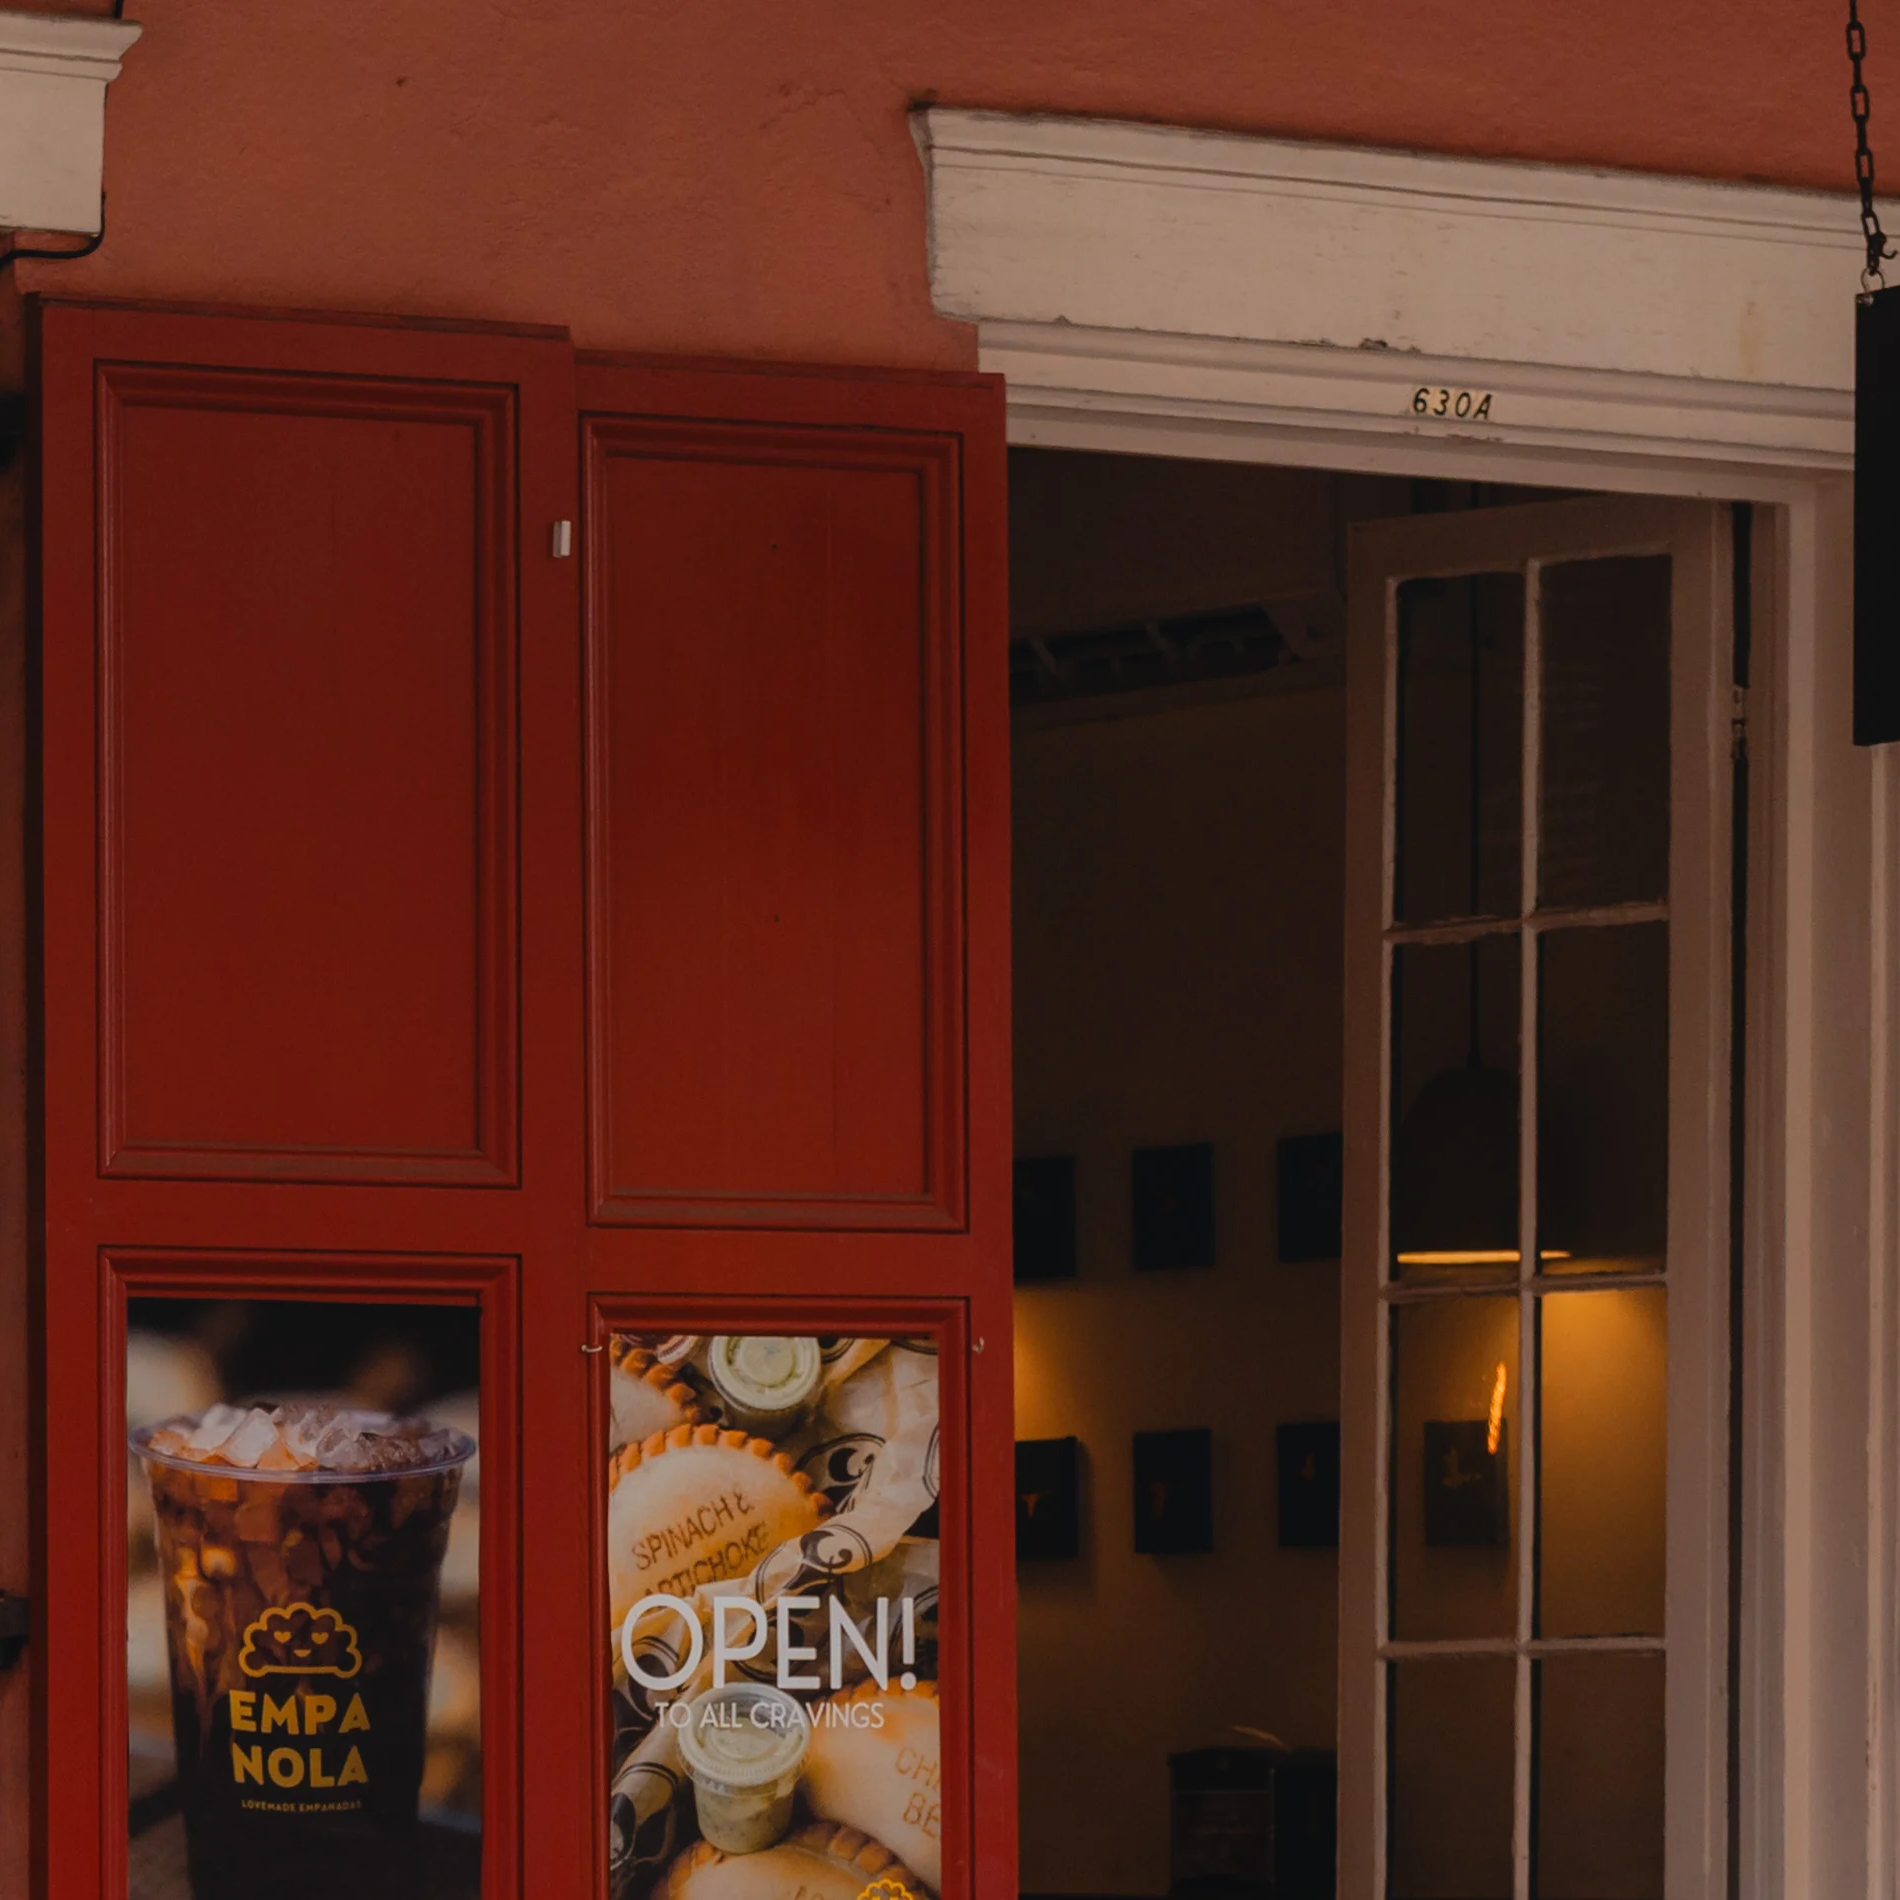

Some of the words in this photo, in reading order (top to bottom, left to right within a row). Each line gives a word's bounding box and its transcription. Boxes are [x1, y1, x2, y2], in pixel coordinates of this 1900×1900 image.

[1413, 387, 1492, 420] 630A
[632, 1496, 734, 1570] SPINACH
[644, 1521, 768, 1598] RTICHOKE
[621, 1595, 916, 1692] OPEN!
[229, 1690, 371, 1735] EMPA
[655, 1703, 691, 1729] TO
[699, 1703, 743, 1729] ALL
[750, 1702, 885, 1729] CRAVINGS
[231, 1742, 368, 1788] NOLA
